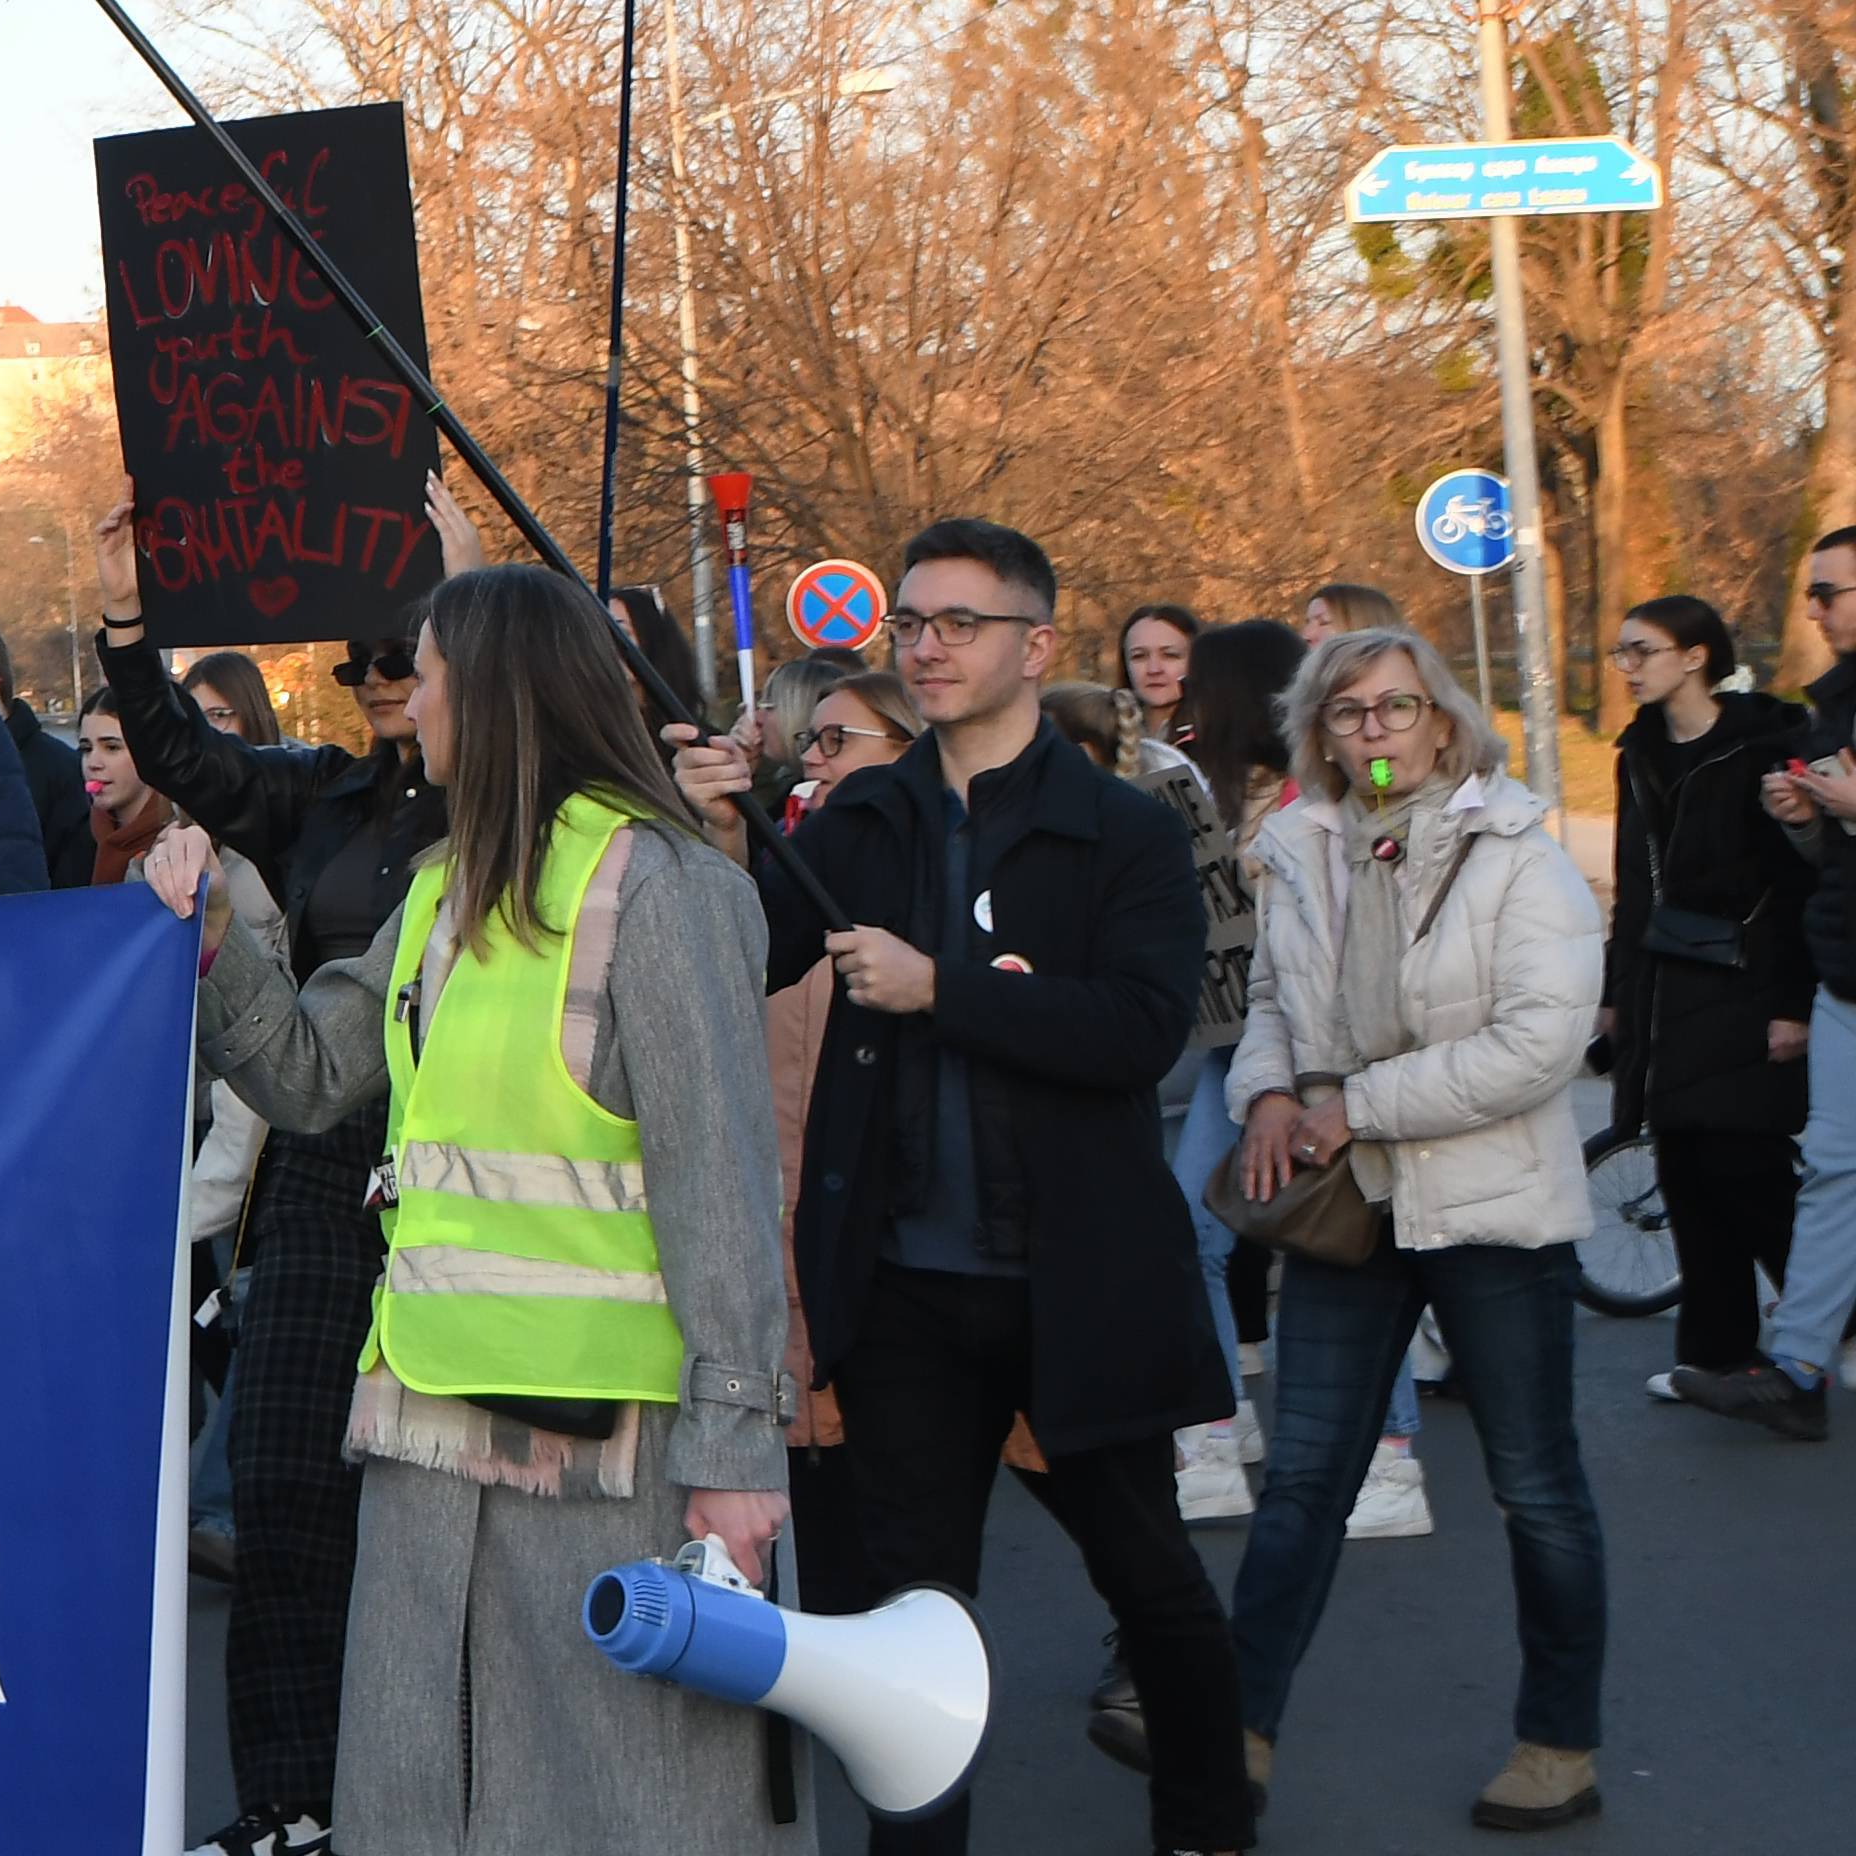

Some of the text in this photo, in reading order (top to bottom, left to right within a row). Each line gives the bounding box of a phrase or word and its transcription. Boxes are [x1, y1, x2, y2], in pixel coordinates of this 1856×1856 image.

[162, 371, 412, 460] AGAINST
[222, 441, 306, 494] the
[139, 496, 430, 590] BRUTALITY
